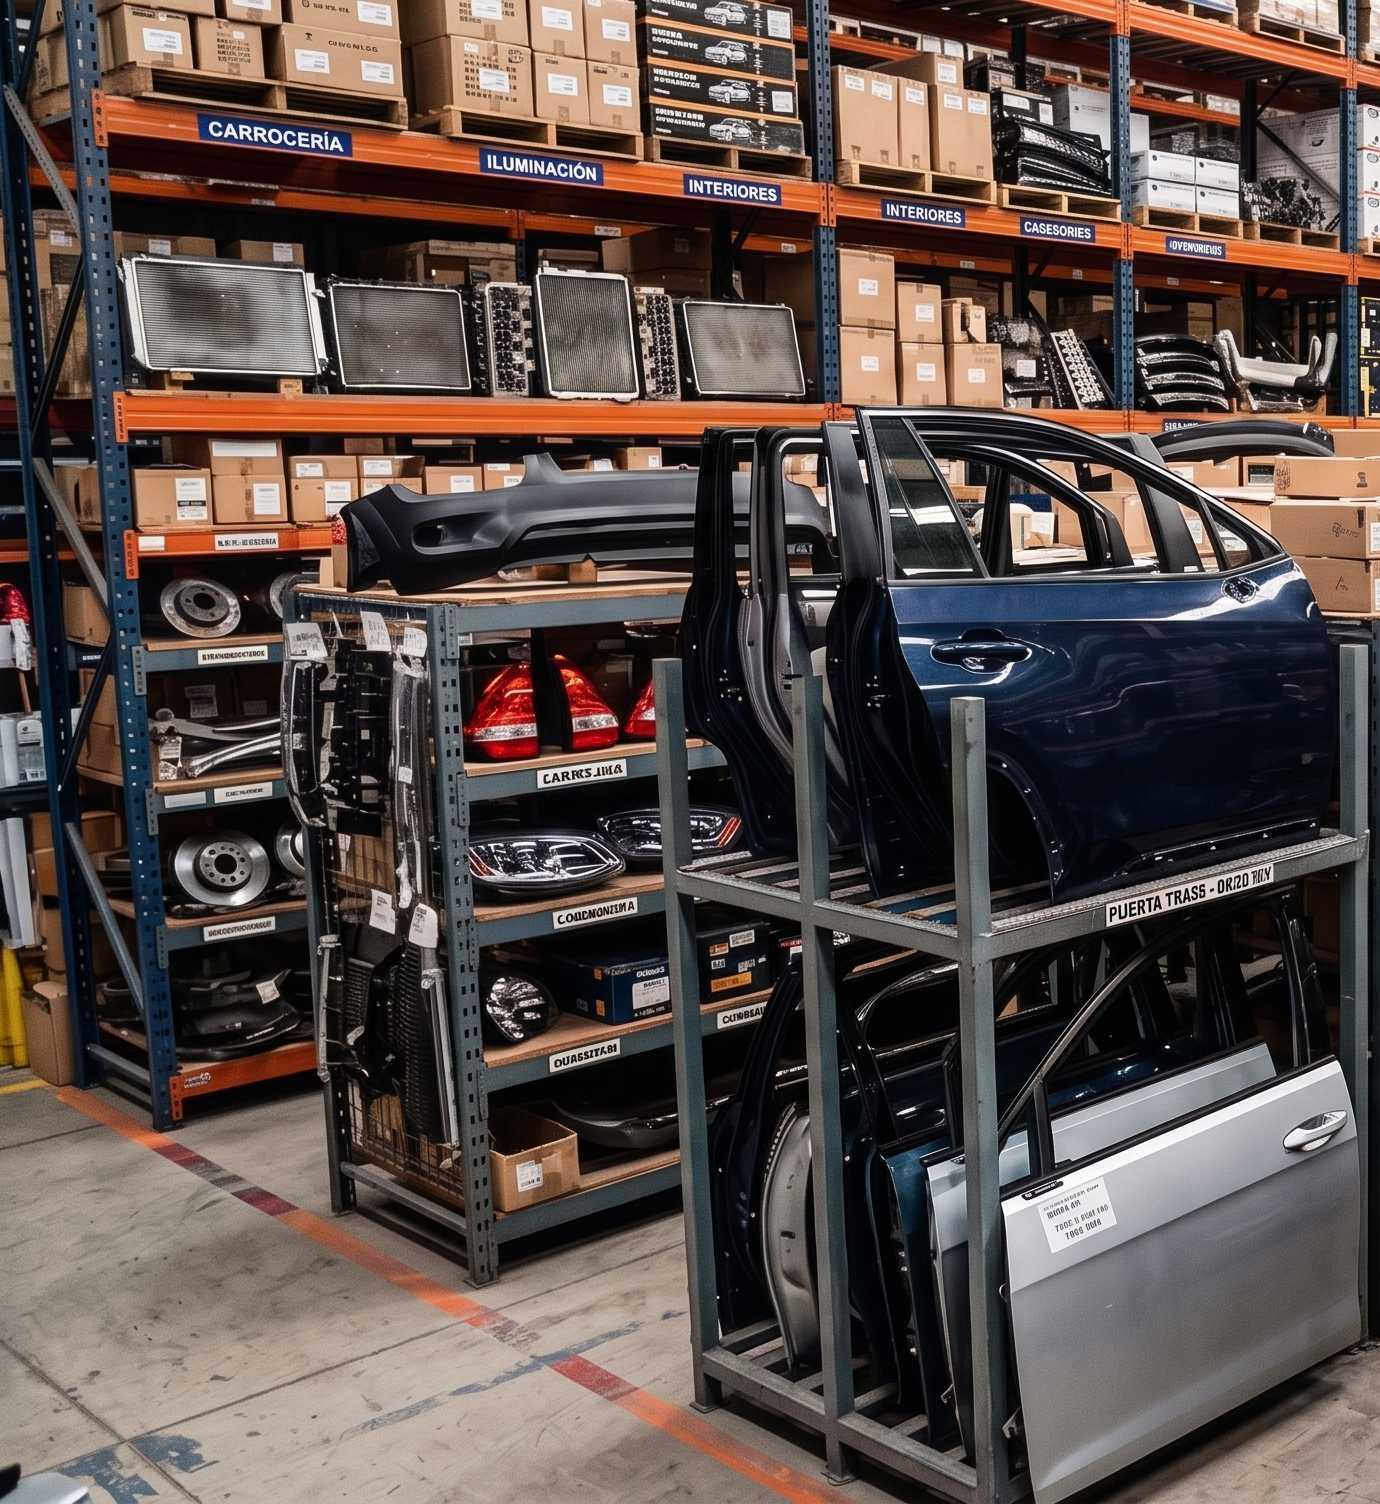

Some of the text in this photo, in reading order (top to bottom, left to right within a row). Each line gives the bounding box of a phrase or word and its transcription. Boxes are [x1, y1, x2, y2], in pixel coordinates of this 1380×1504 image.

[208, 121, 344, 153] CARROCERÍA
[487, 154, 597, 181] ILUMINACIÓN
[689, 179, 778, 202] INTERIORES
[886, 203, 962, 224] INTERIORES
[1024, 221, 1092, 239] CASESORIES
[1109, 895, 1162, 923] PUERTA
